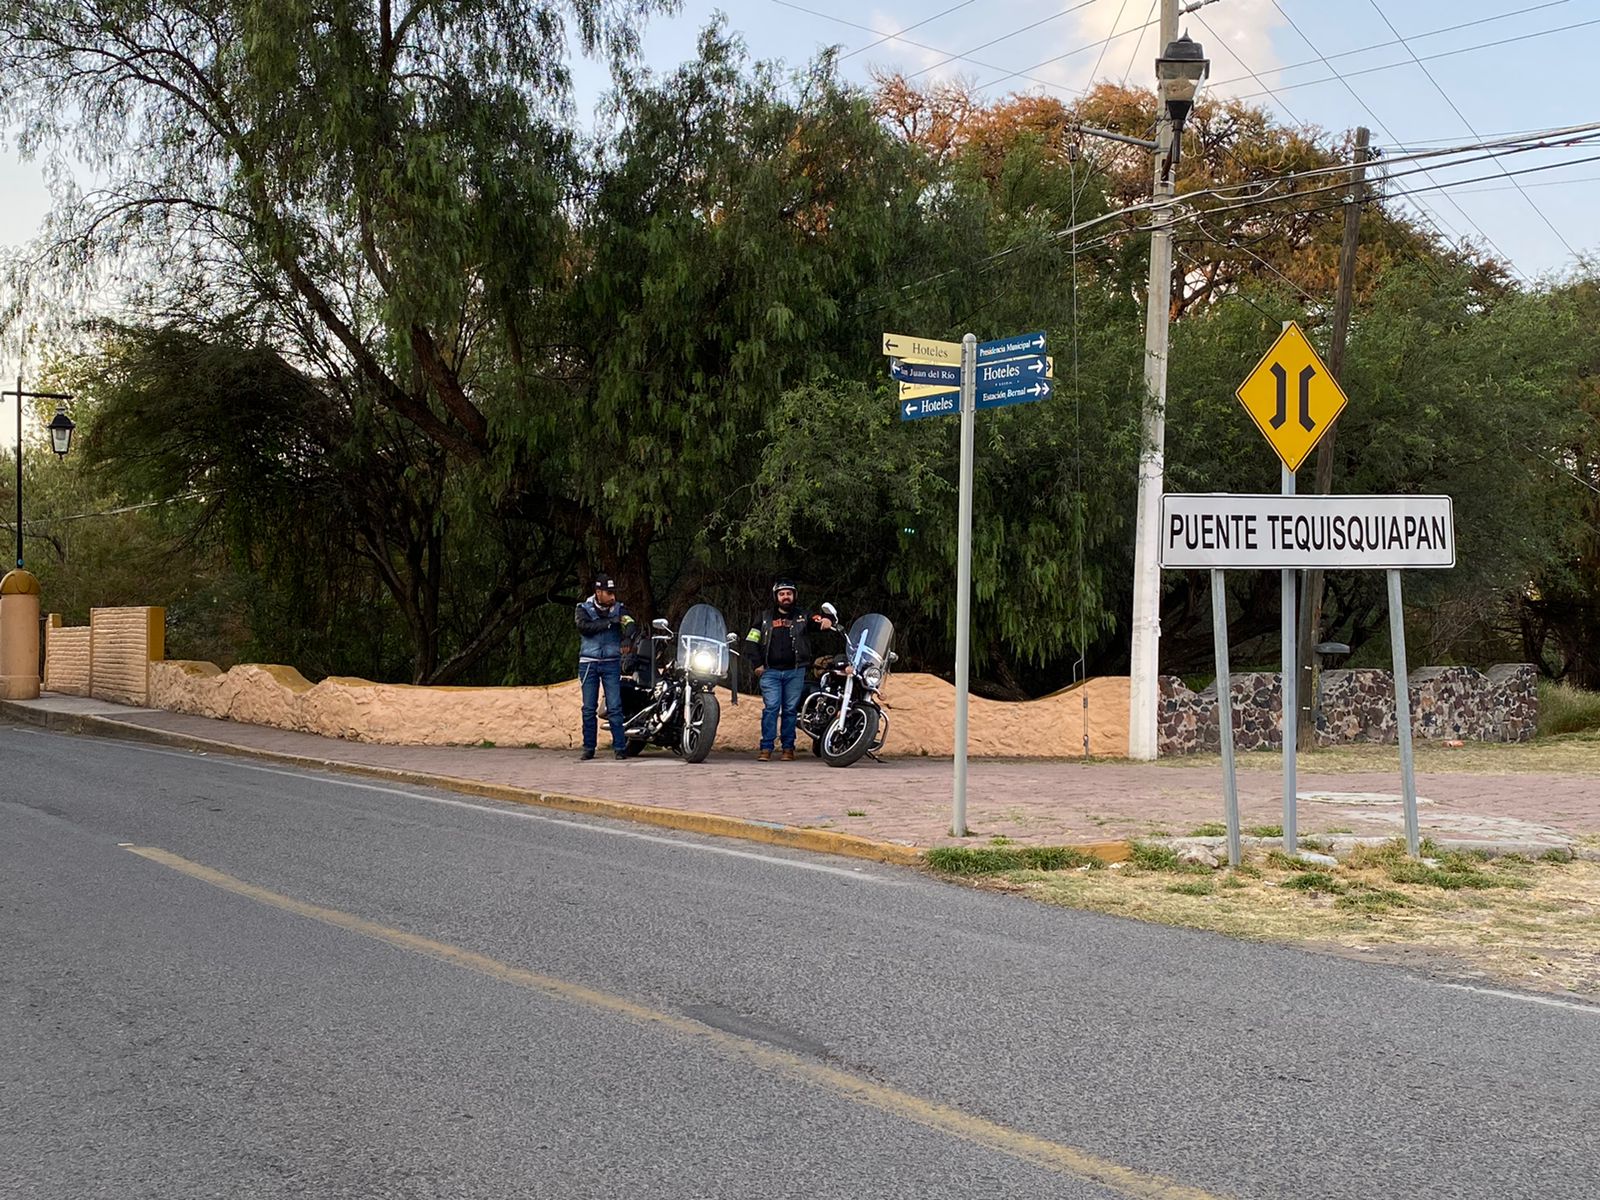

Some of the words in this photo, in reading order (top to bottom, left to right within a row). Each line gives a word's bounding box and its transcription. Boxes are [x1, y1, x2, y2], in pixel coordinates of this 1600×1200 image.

[912, 342, 948, 358] Hoteles
[1006, 339, 1031, 351] Municipal
[909, 368, 927, 377] Juan
[927, 370, 939, 379] del
[941, 370, 955, 380] Río
[983, 364, 1020, 381] Hoteles
[1007, 386, 1026, 398] Bernal
[921, 397, 953, 413] Hoteles
[1170, 514, 1258, 550] PUENTE
[1267, 515, 1447, 553] TEQUISQUIAPAN
